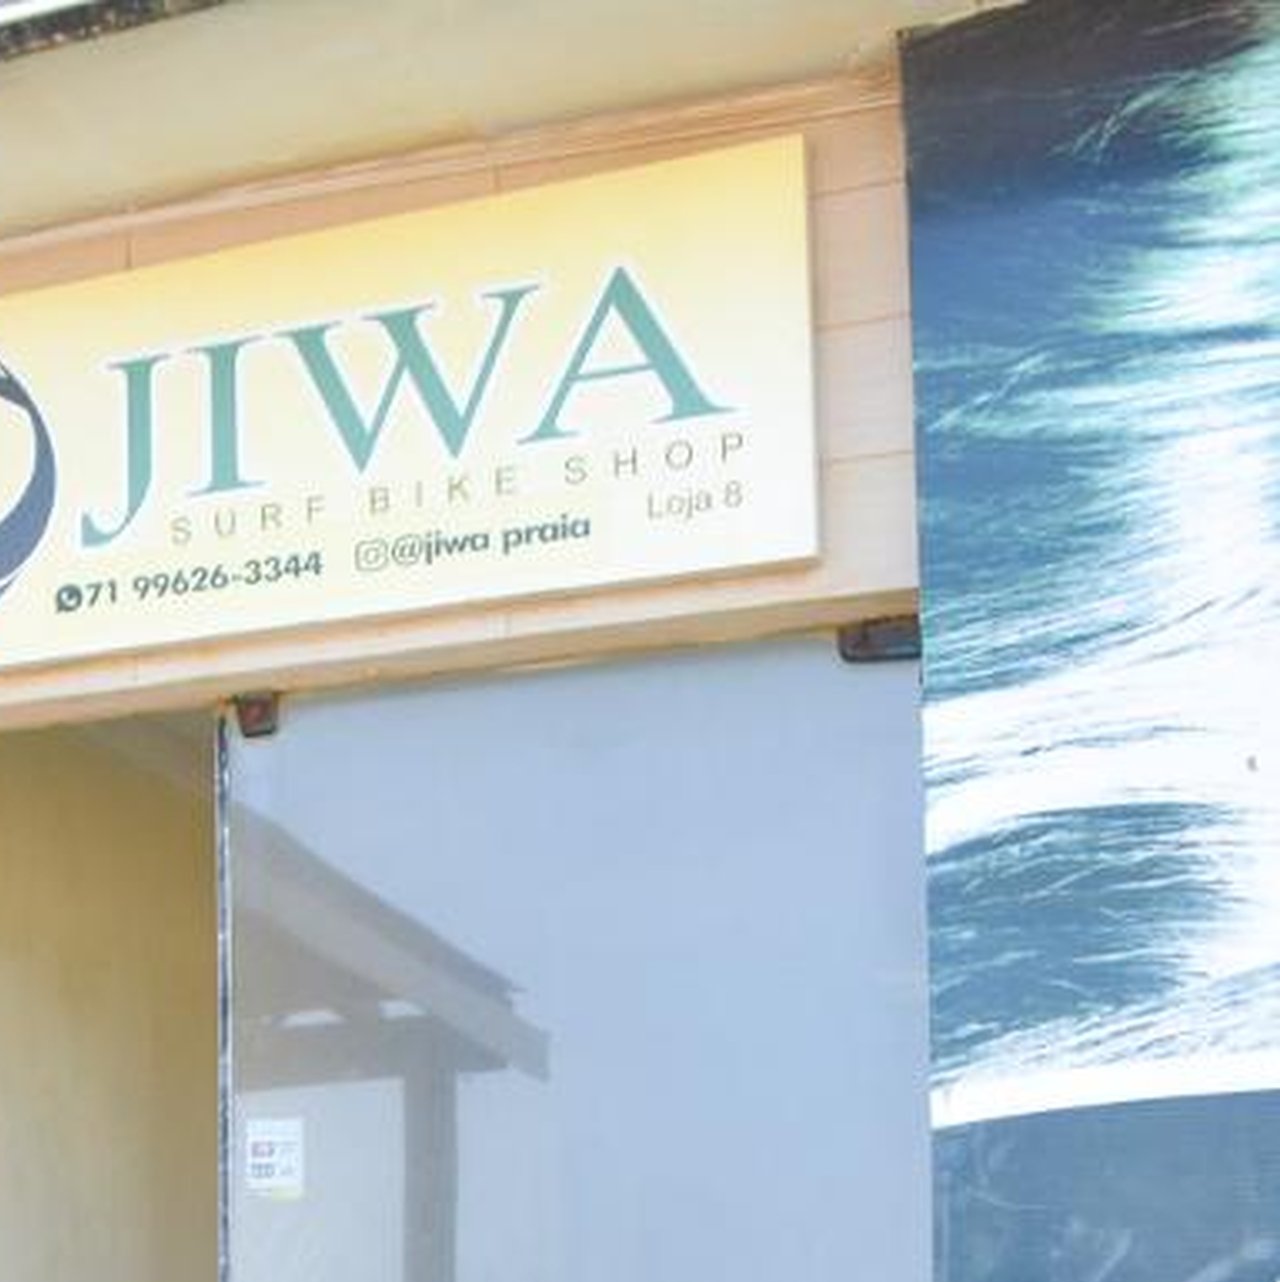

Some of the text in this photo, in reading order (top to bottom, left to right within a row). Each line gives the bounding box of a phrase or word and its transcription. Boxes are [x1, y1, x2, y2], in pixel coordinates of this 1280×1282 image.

[80, 266, 739, 548] JIWA
[170, 432, 744, 546] SURF BIKE SHOP
[646, 481, 744, 521] Loja 8
[86, 580, 118, 607] 71
[132, 550, 324, 601] 99626-3344
[501, 513, 592, 556] praia
